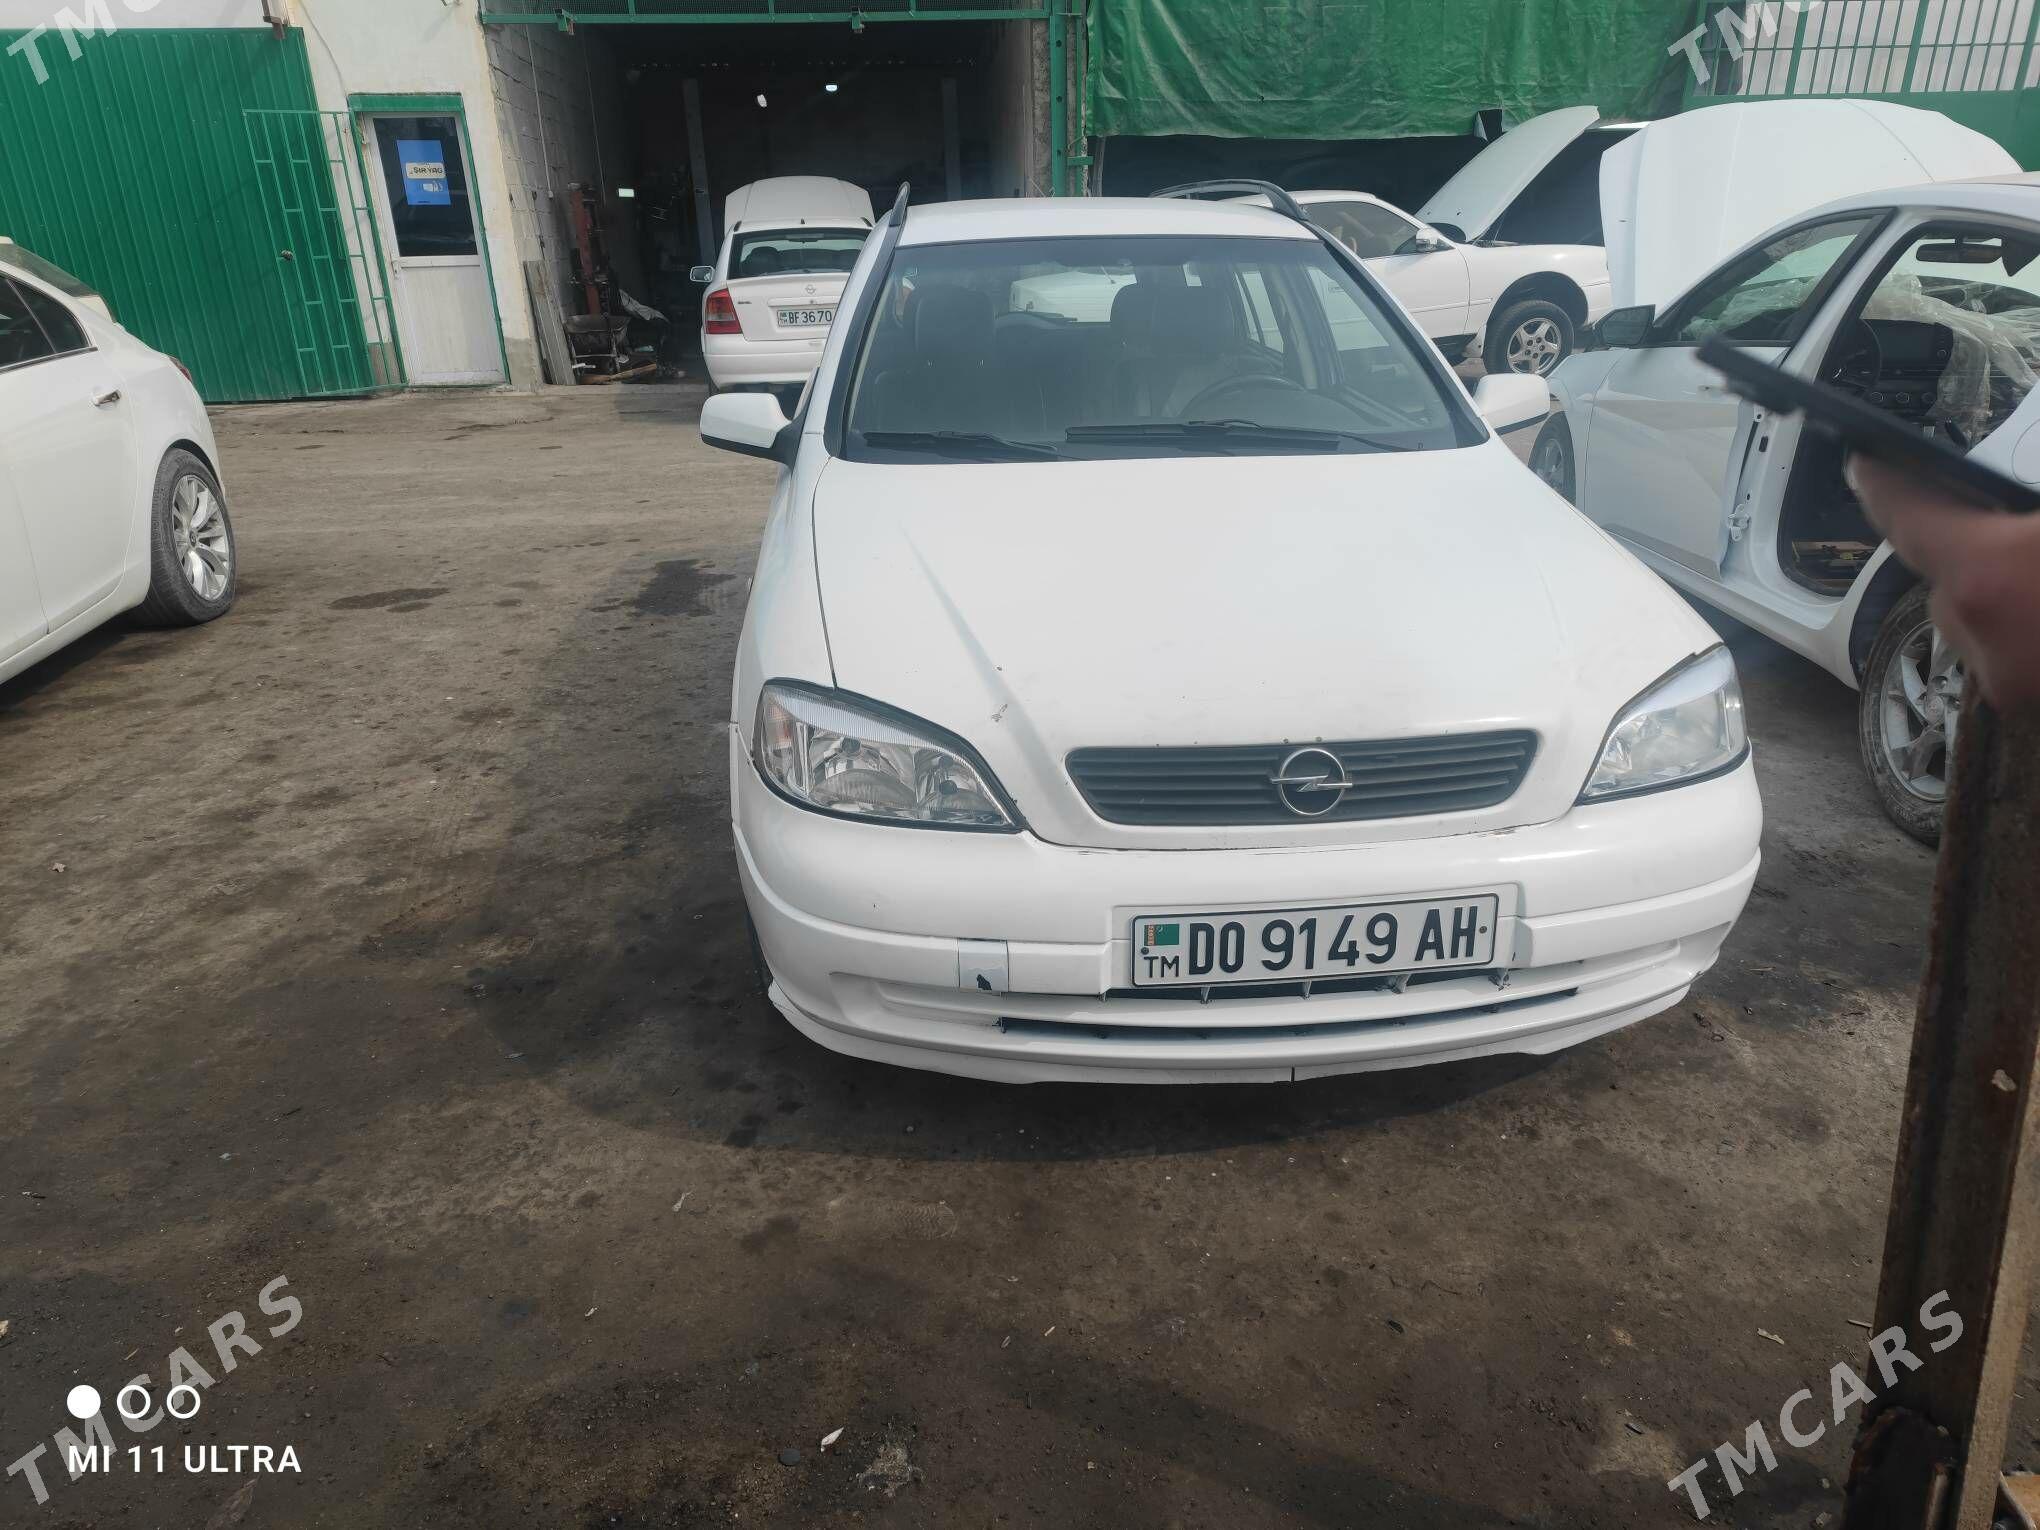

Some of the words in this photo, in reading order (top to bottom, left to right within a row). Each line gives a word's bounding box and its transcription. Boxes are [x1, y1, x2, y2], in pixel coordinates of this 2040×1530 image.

[788, 311, 799, 324] BF
[1261, 913, 1398, 971] 9149
[1415, 905, 1479, 961] AH
[1143, 955, 1180, 978] TM
